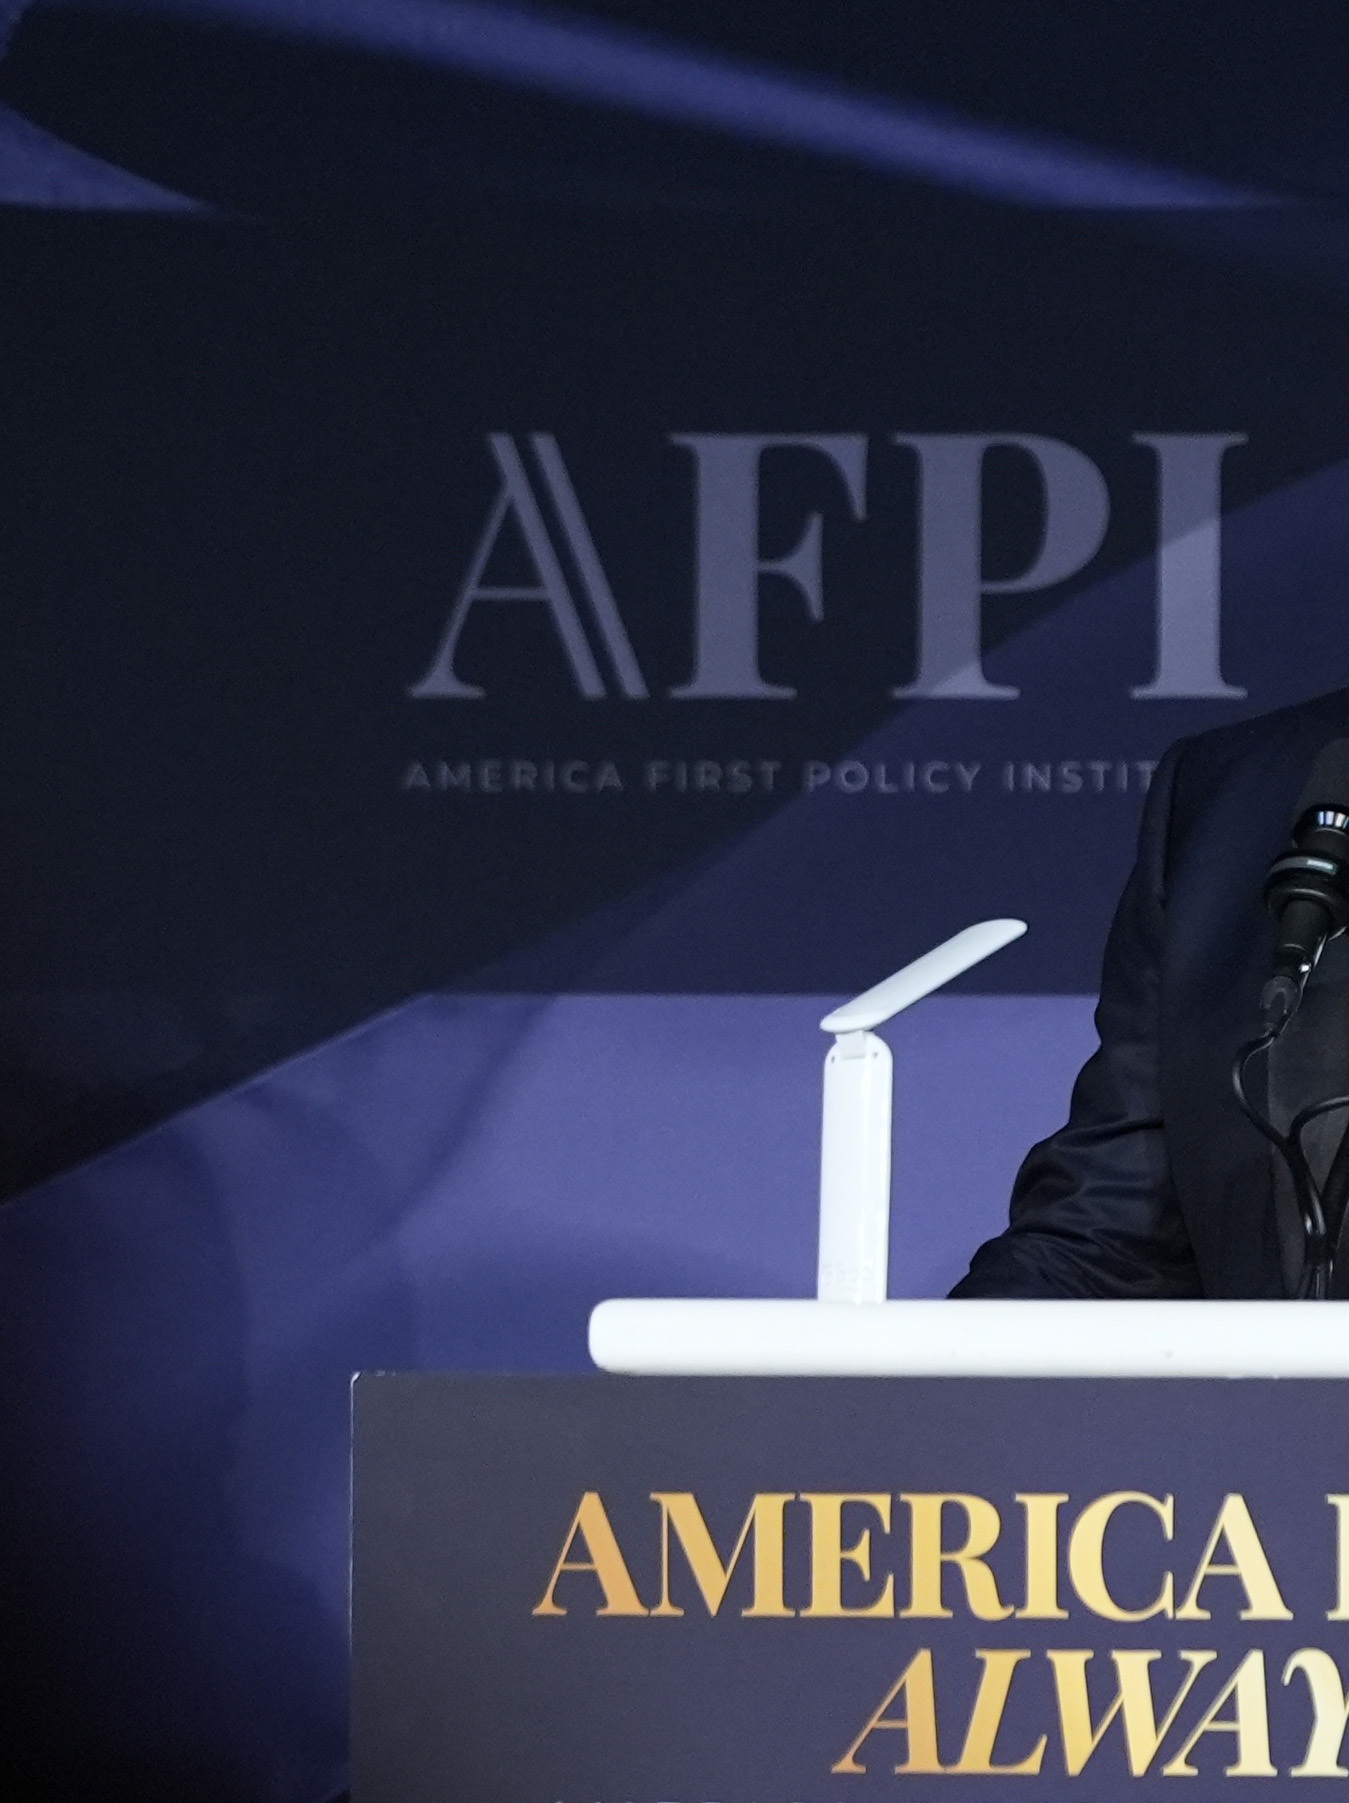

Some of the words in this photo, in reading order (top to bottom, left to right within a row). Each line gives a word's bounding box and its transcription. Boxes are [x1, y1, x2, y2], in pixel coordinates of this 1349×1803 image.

[409, 432, 1248, 699] AFPI
[403, 760, 624, 794] AMERICA
[645, 760, 781, 794] FIRST
[806, 759, 981, 794] POLICY
[532, 1491, 1294, 1622] AMERICA
